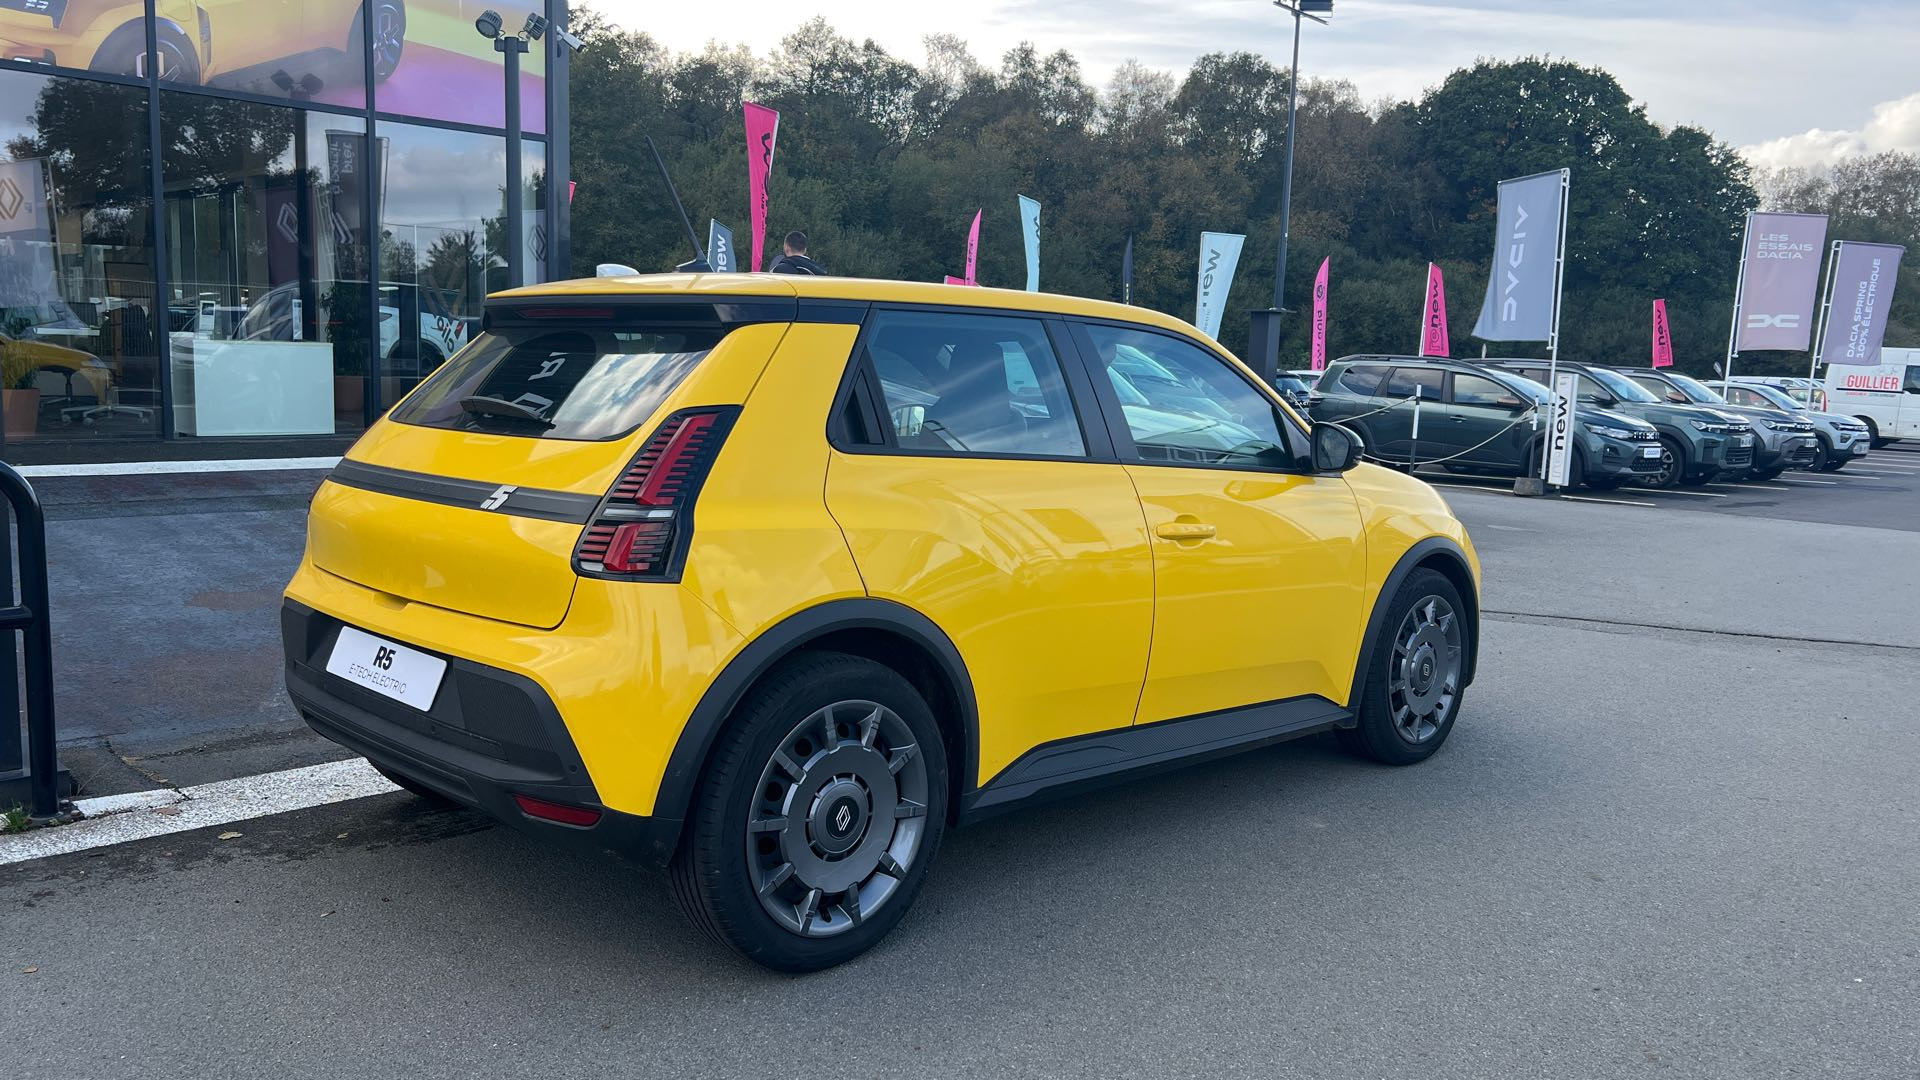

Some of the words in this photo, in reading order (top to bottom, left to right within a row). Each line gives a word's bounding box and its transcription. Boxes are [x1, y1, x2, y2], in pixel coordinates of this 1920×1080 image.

[1758, 241, 1814, 252] ESSAIS
[1759, 232, 1790, 242] LES
[1756, 250, 1803, 260] DACIA
[1861, 257, 1881, 328] ÉLECTRIQUE
[1846, 323, 1860, 359] DACIA
[1854, 280, 1868, 323] SPRING
[1856, 328, 1869, 359] 100%
[1846, 374, 1899, 390] GUILLIER
[480, 484, 518, 511] 5
[372, 645, 397, 671] R5
[348, 662, 374, 681] E-TECH
[371, 672, 407, 695] ELECTRIC
